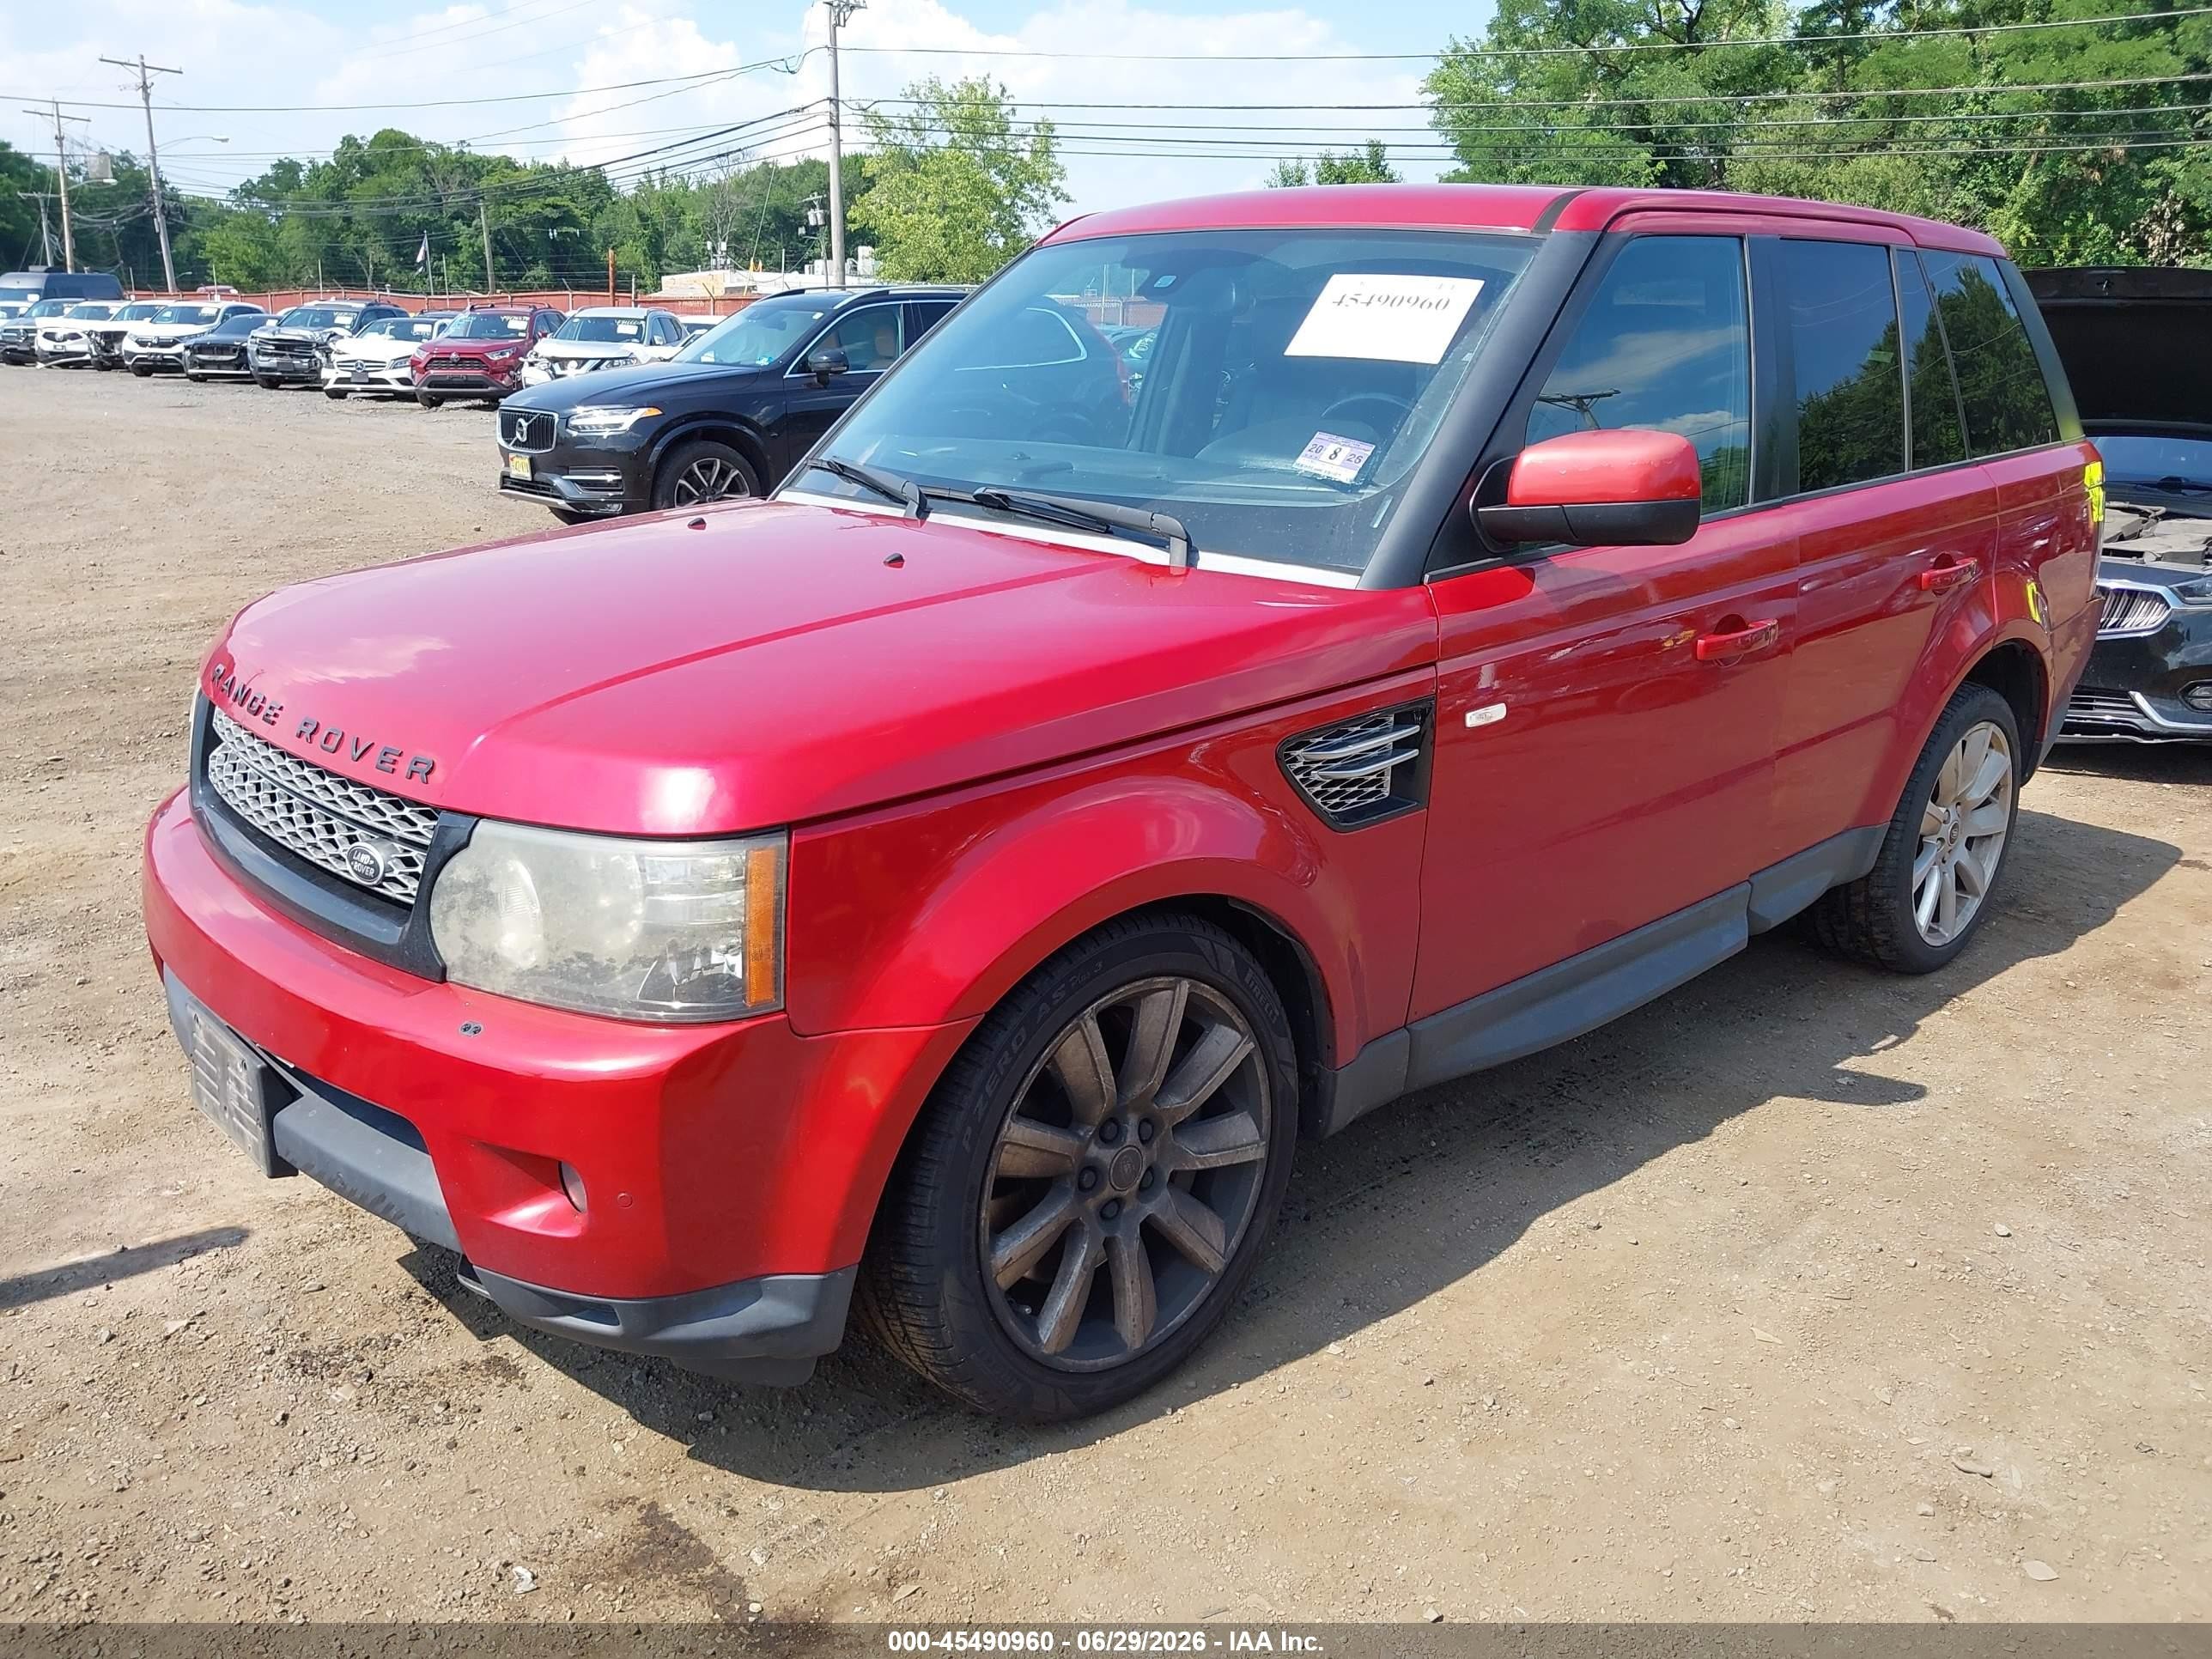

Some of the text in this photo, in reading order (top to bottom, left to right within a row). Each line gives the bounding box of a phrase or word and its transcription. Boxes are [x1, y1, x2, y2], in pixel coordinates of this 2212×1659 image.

[1308, 443, 1324, 454] 20
[1328, 447, 1342, 460] 8
[211, 663, 435, 785] RANGE ROVER
[353, 860, 375, 878] ROVER
